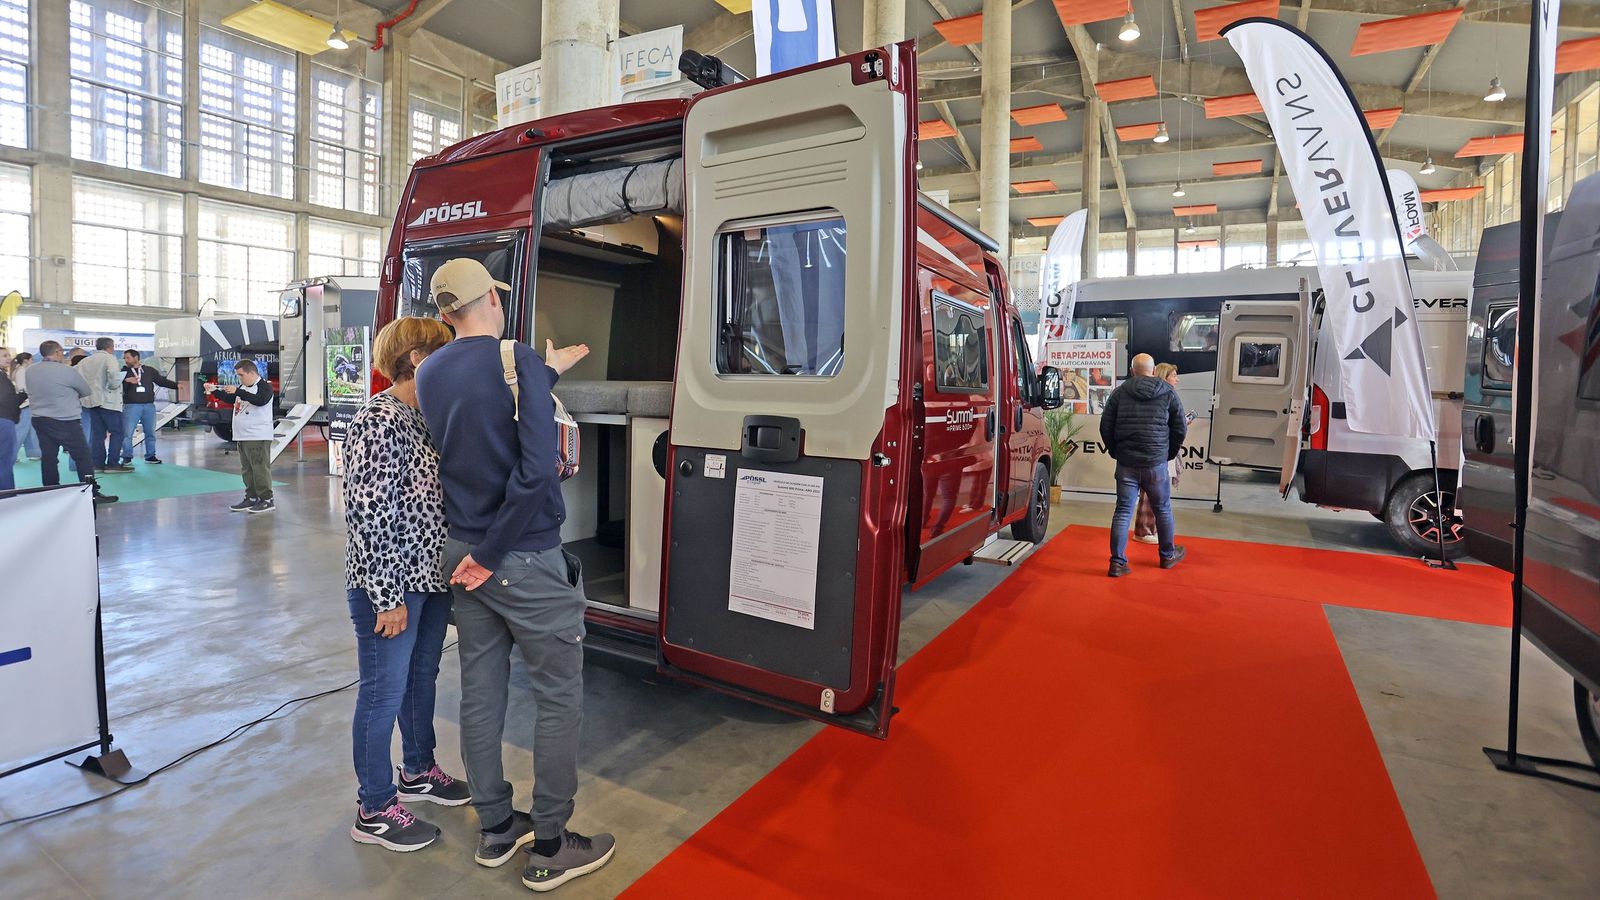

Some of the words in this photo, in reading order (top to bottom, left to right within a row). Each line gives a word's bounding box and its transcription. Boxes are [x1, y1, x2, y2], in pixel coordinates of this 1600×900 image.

[620, 45, 674, 71] IFECA
[424, 200, 488, 224] PÖSSL
[1051, 351, 1112, 359] RETAPIZAMOS
